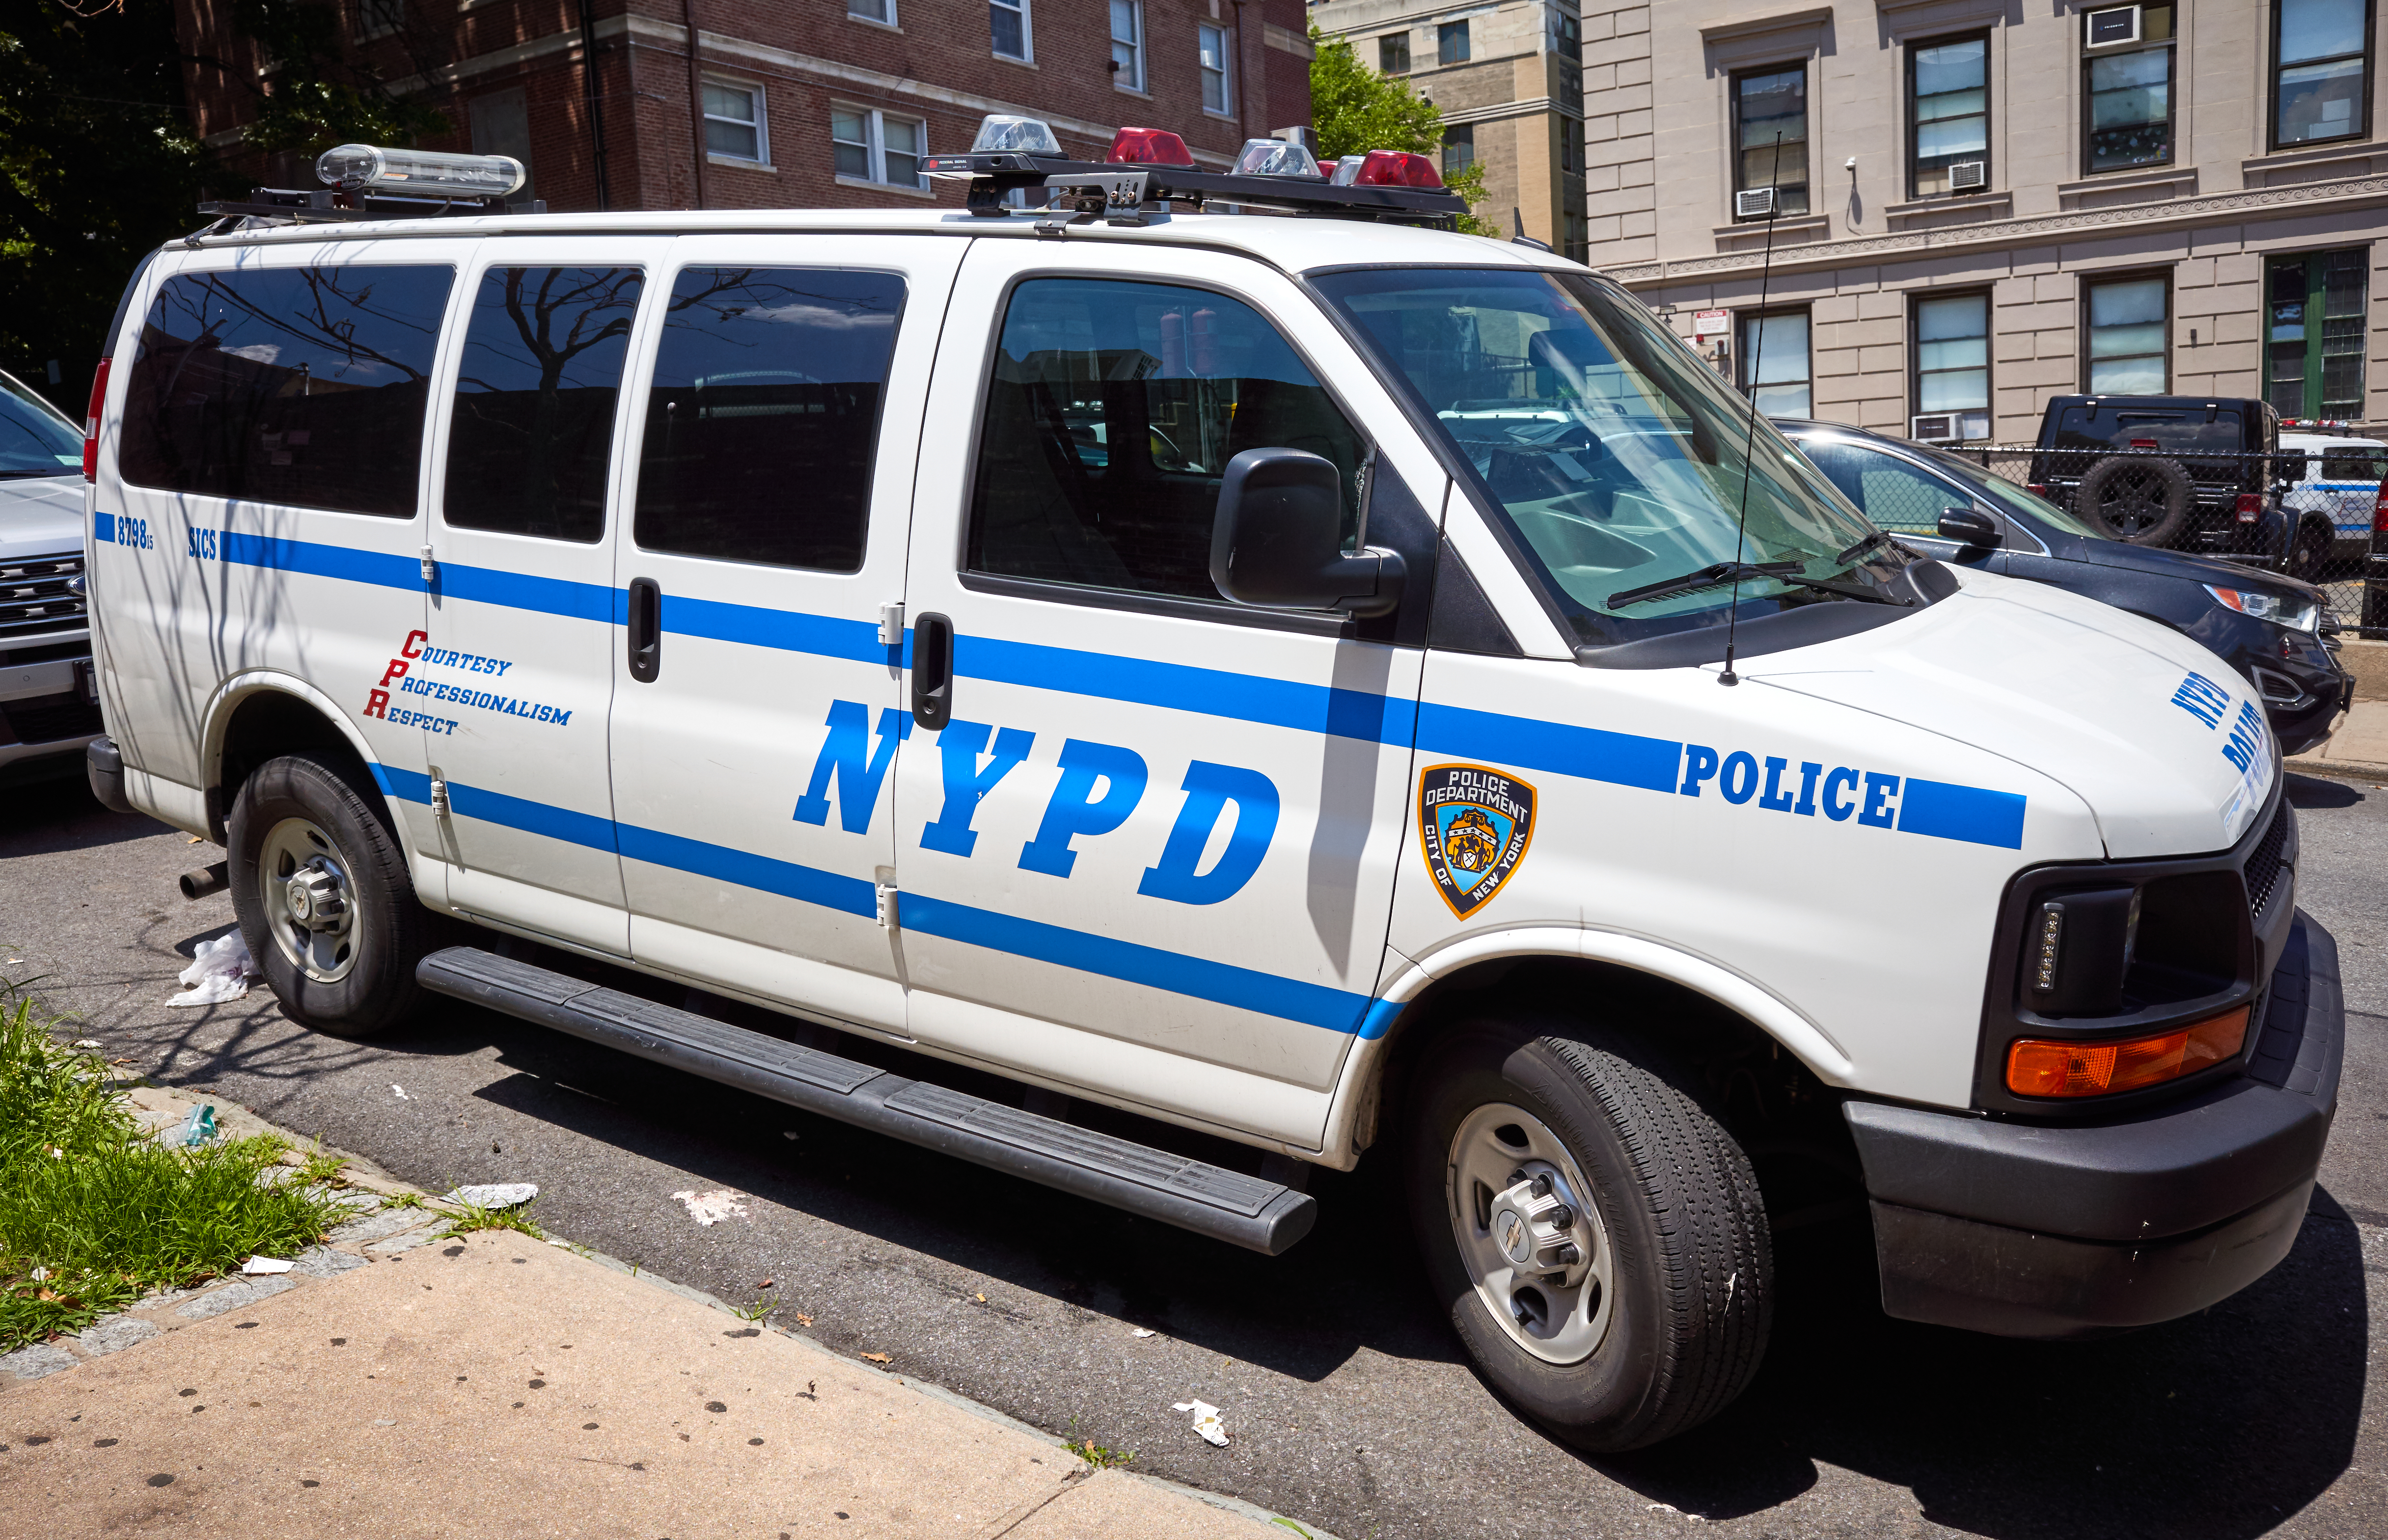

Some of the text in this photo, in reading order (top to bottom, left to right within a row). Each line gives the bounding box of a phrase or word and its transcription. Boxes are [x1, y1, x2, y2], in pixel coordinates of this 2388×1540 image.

[118, 516, 216, 560] 8798 15 SICS
[401, 629, 513, 676] COURTESY
[363, 689, 458, 735] RESPECT
[379, 659, 573, 726] PROFESSIONALISM
[2170, 671, 2230, 731] NYPD
[792, 699, 1280, 906] NYPD
[1426, 786, 1528, 823] DEPARTMENT
[1449, 771, 1510, 797] POLICE
[1680, 743, 1900, 829] POLICE
[1425, 825, 1452, 886] CITY OF
[1472, 832, 1526, 901] NEW YORK
[1531, 1076, 1639, 1280] BRIDGESTONE
